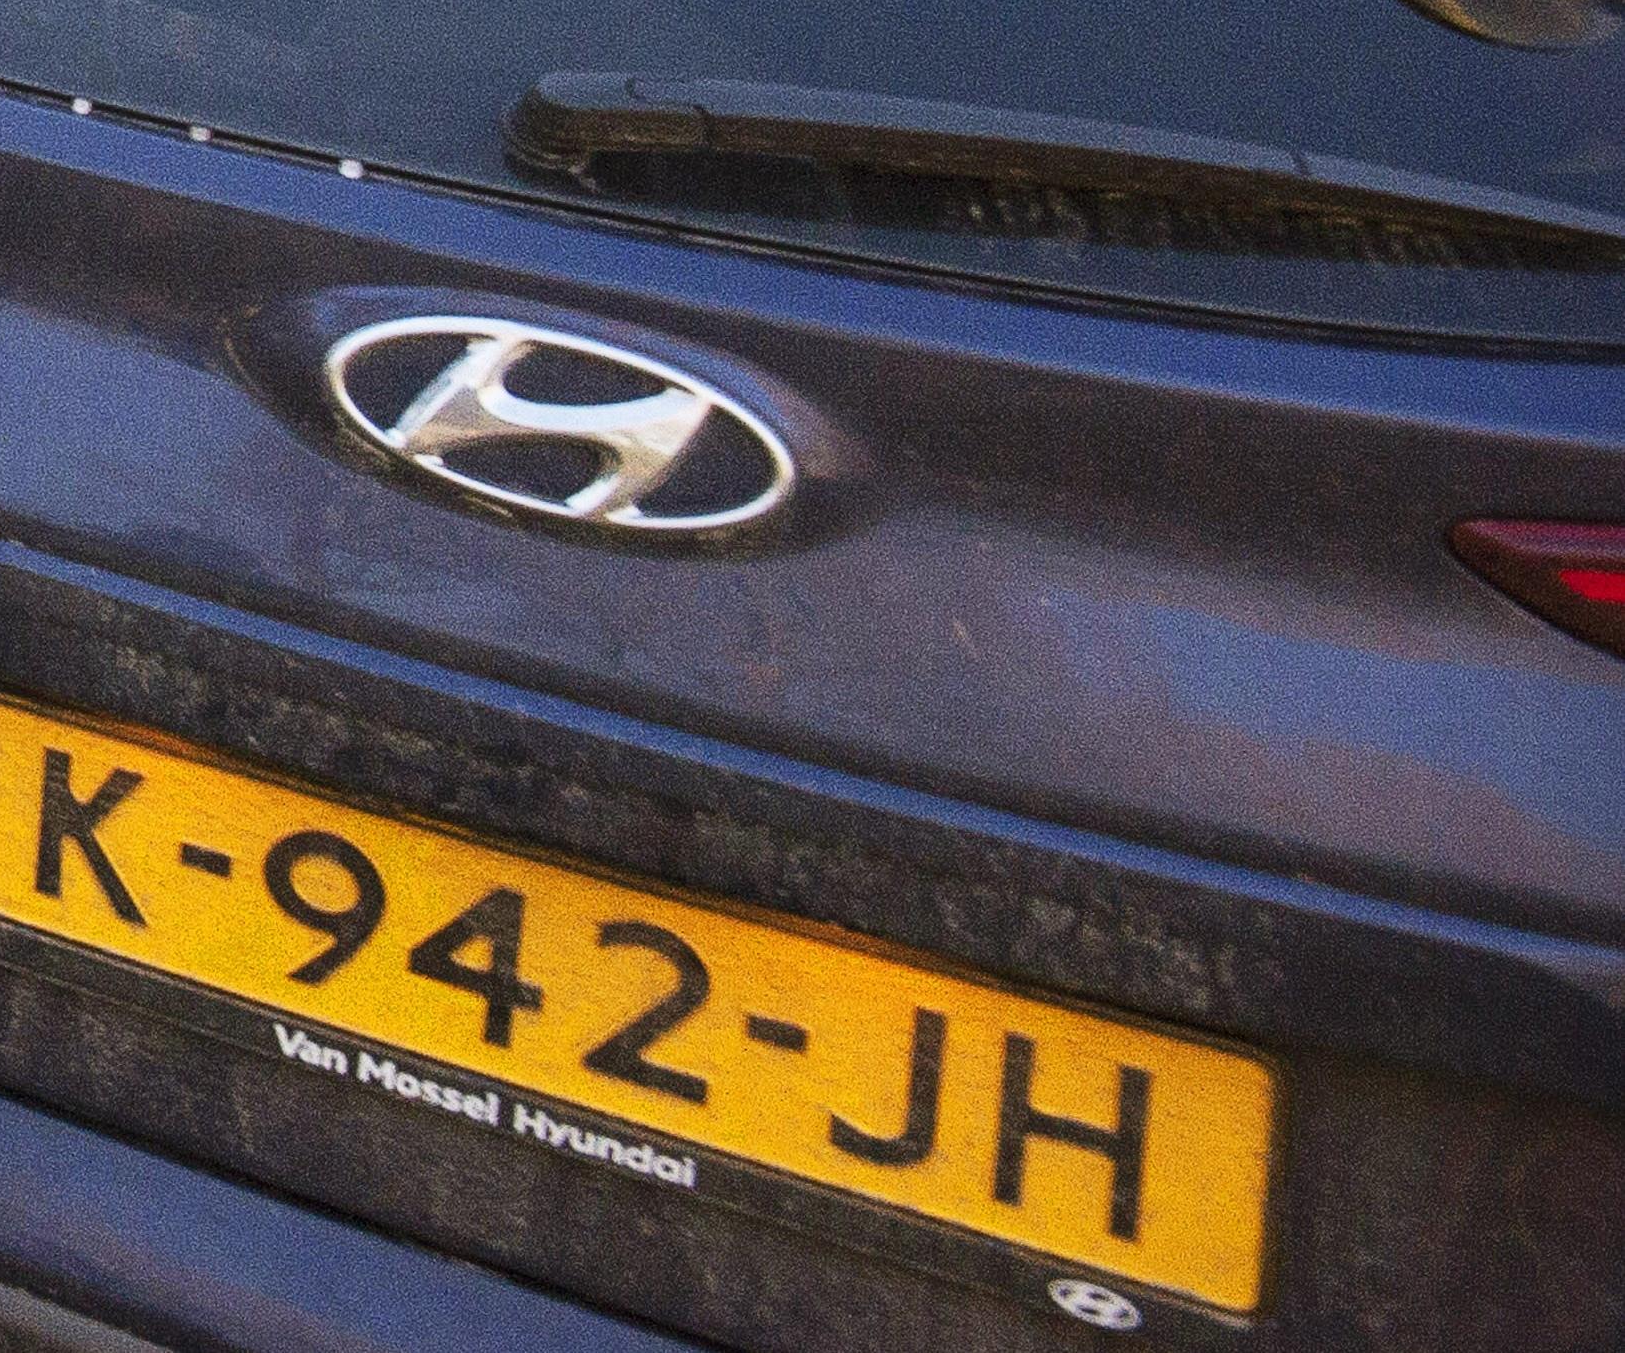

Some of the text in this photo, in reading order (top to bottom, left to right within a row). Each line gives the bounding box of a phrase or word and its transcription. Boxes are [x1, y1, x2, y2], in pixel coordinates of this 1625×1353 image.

[34, 746, 1152, 1243] K-942-JH
[273, 1023, 699, 1187] Van Mossel Hyundai
